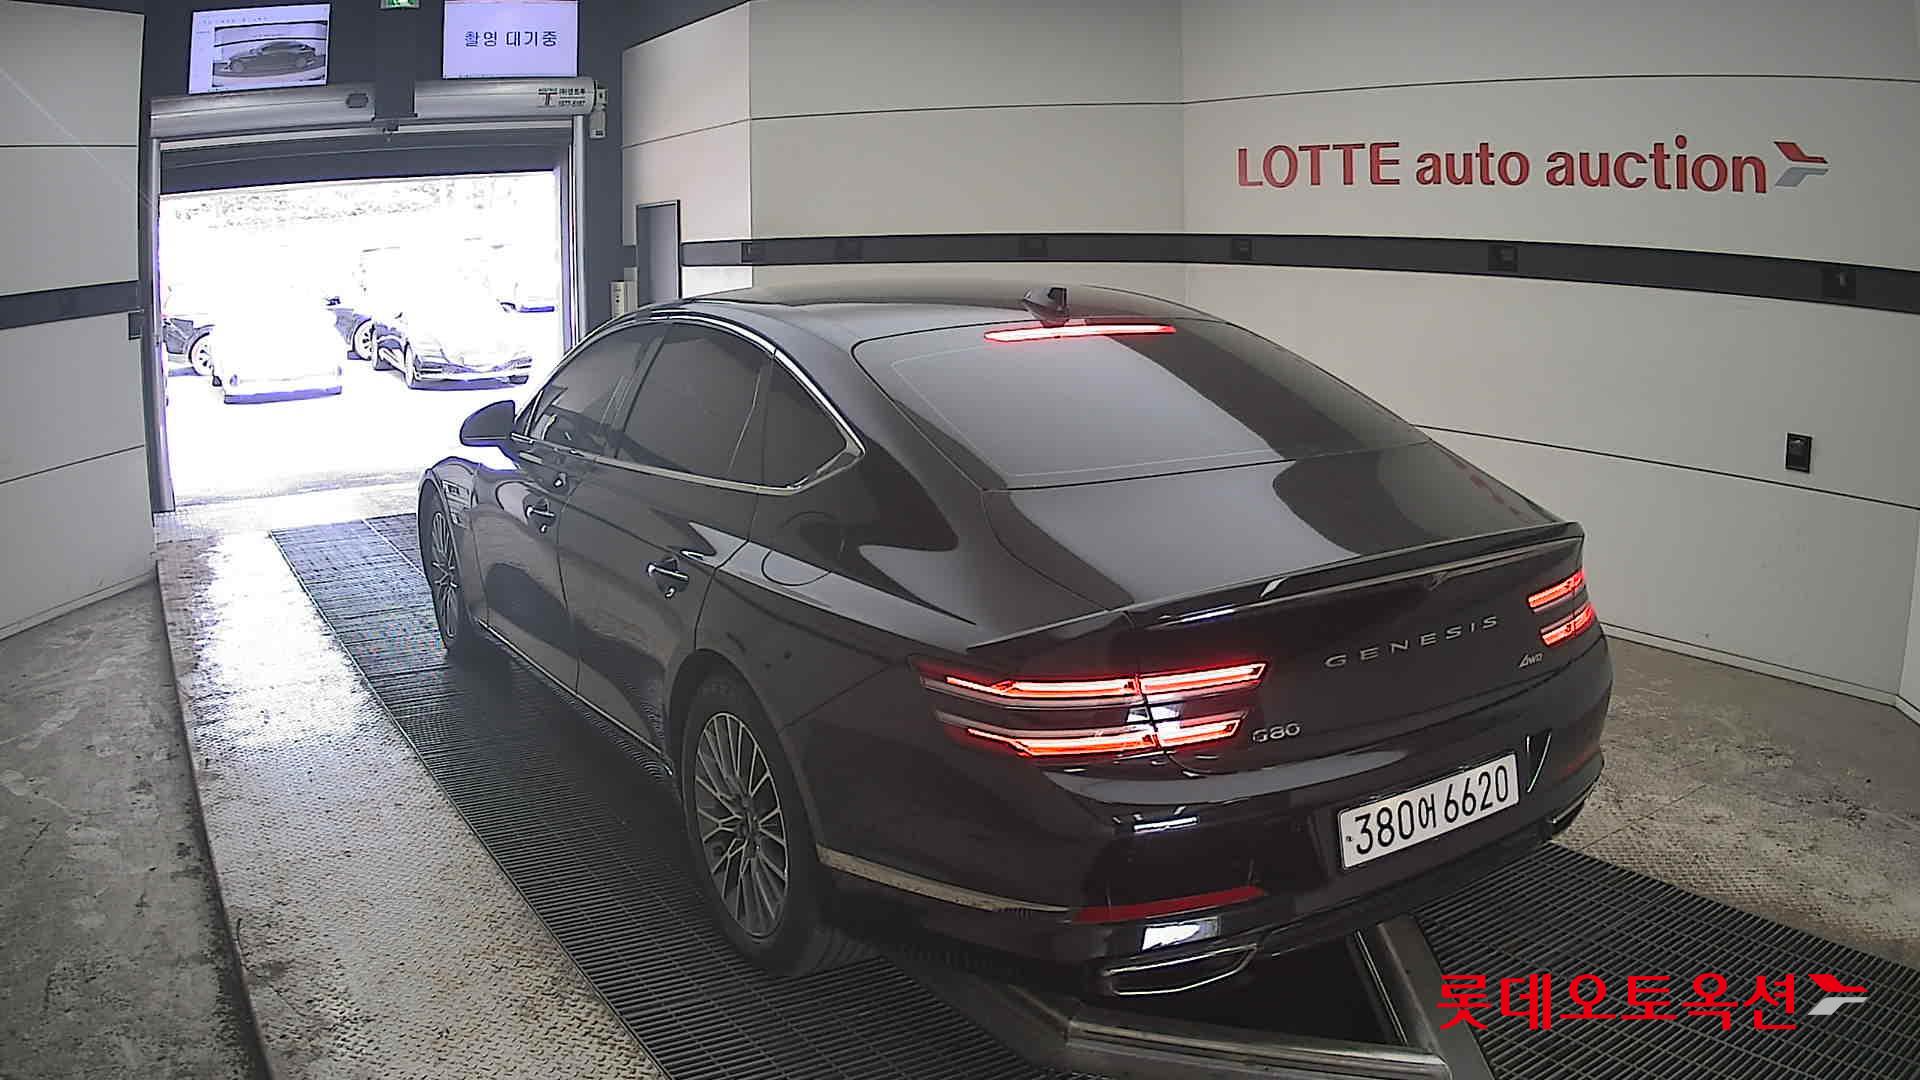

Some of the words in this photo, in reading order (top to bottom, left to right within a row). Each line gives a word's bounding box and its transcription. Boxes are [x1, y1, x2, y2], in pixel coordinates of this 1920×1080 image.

[465, 31, 497, 47] 촬영
[506, 31, 557, 47] 대기중
[1238, 142, 1400, 188] LOTTE
[1416, 143, 1530, 186] auto
[1546, 135, 1767, 194] auction
[1325, 616, 1497, 668] GENESIS
[1252, 723, 1300, 742] G80
